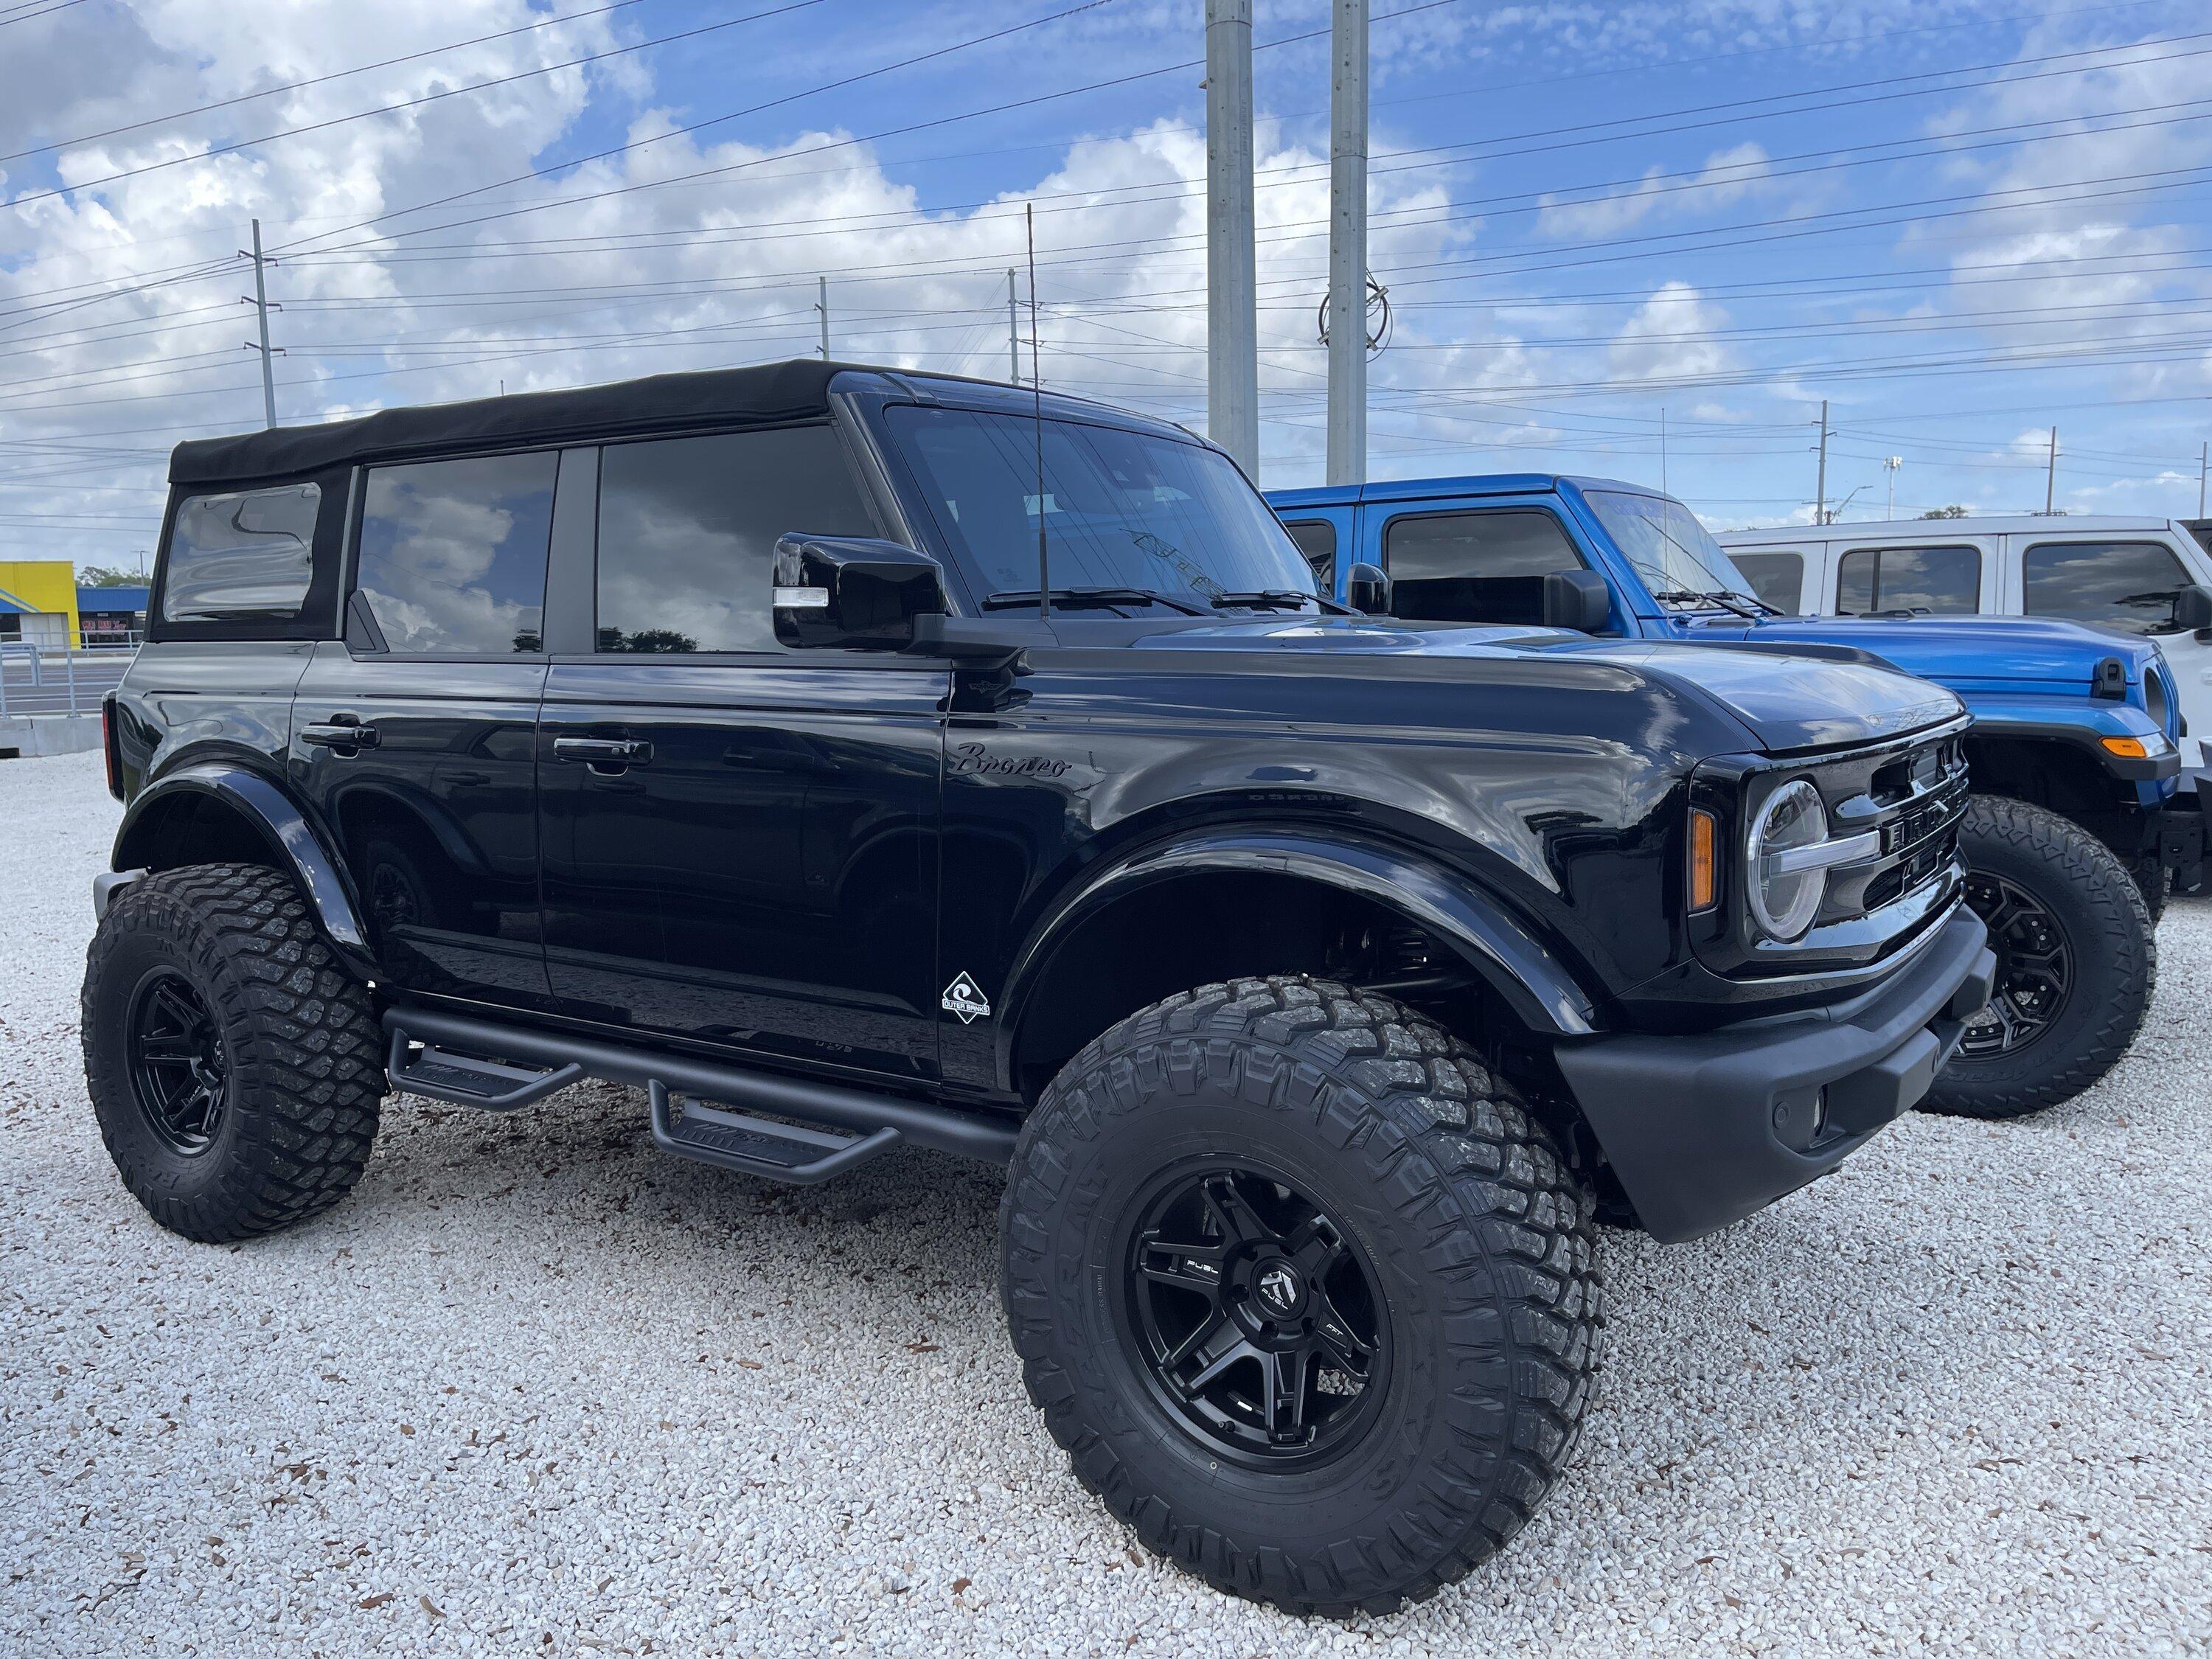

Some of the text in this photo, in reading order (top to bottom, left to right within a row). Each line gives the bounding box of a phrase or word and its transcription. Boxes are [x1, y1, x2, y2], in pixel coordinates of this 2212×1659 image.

[947, 742, 1072, 778] Bronco
[944, 1001, 988, 1013] OUTER BANKS
[1187, 1259, 1219, 1274] FUEL
[1262, 1287, 1288, 1310] FUEL
[1326, 1324, 1343, 1335] FFT
